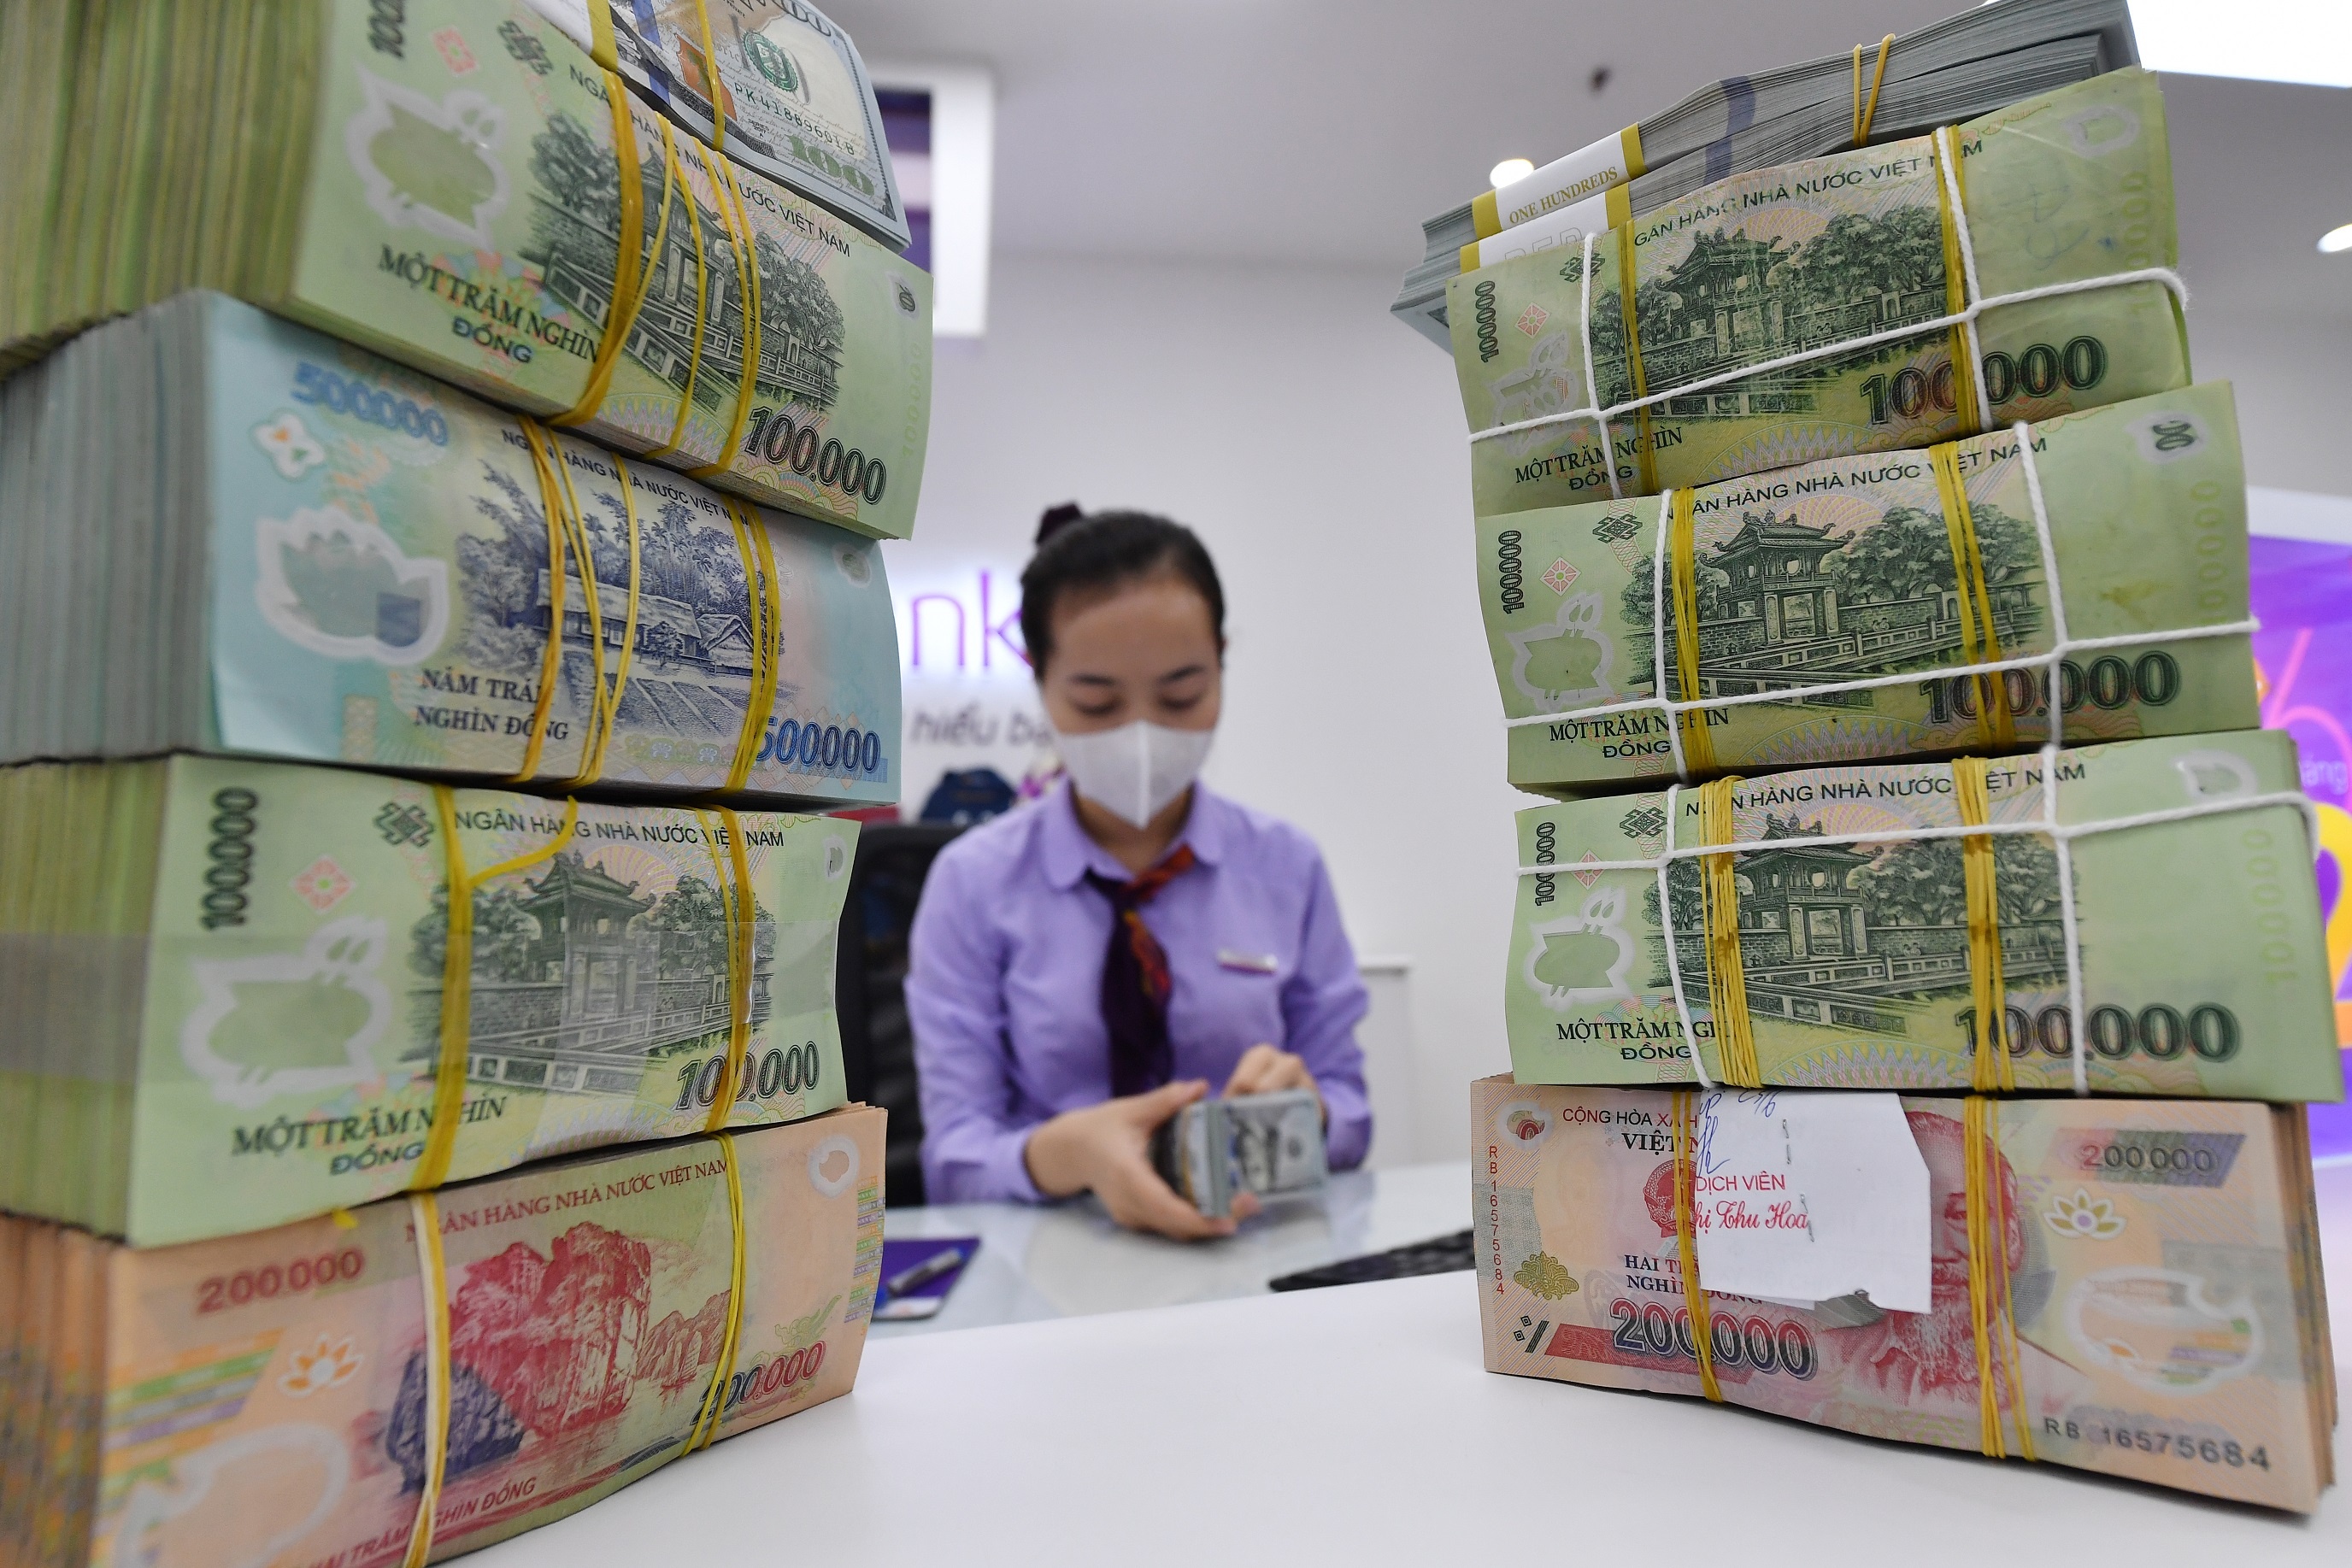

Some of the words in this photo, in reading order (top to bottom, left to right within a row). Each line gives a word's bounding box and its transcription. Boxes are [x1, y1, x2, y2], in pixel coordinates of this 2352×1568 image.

[785, 134, 875, 196] 100
[1743, 184, 1790, 208] NHÀ
[1796, 170, 1863, 197] NƯỚC
[1869, 155, 1919, 179] VIỆT
[1509, 203, 1538, 224] ONE
[1540, 167, 1619, 211] HUNDREDS
[779, 204, 814, 231] VIỆT
[819, 226, 850, 257] NAM
[444, 274, 523, 329] TRĂM
[524, 310, 601, 363] NGHÌN
[744, 406, 886, 505] 100.000
[1514, 457, 1553, 483] MỘT
[646, 480, 689, 505] NƯỚC
[689, 493, 720, 518] VIỆT
[1726, 483, 1788, 508] HÀNG
[1796, 474, 1844, 495] NHÀ
[1851, 463, 1920, 487] NƯỚC
[1498, 530, 1525, 614] 100.000
[420, 666, 479, 696] NĂM
[1920, 649, 2179, 724] 100.000
[414, 705, 498, 733] NGHÌN
[1549, 719, 1587, 743] MỘT
[1588, 714, 1649, 737] TRĂM
[1602, 737, 1671, 759] ĐỒNG
[1751, 784, 1814, 807] HÀNG
[1821, 778, 1873, 800] NHÀ
[1879, 776, 1952, 797] NƯỚC
[455, 807, 524, 833] NGÂN
[597, 819, 639, 842] NHÀ
[643, 822, 698, 845] NƯỚC
[746, 830, 785, 848] NAM
[1556, 1018, 1603, 1043] MỘT
[1604, 1017, 1672, 1040] TRĂM
[1620, 1042, 1692, 1060] ĐỒNG
[315, 1107, 410, 1147] TRĂM
[1562, 1106, 1611, 1126] CỘNG
[1616, 1108, 1653, 1126] HÒA
[485, 1197, 550, 1226] HÀNG
[556, 1183, 603, 1211] NHÀ
[606, 1172, 656, 1198] NƯỚC
[659, 1164, 693, 1188] VIỆT
[1696, 1175, 1738, 1195] DỊCH
[1742, 1170, 1786, 1191] VIÊN
[1716, 1200, 1761, 1229] Thu
[1765, 1200, 1808, 1229] Hoa
[1625, 1254, 1661, 1271] HAI
[2102, 1426, 2272, 1471] 16575684
